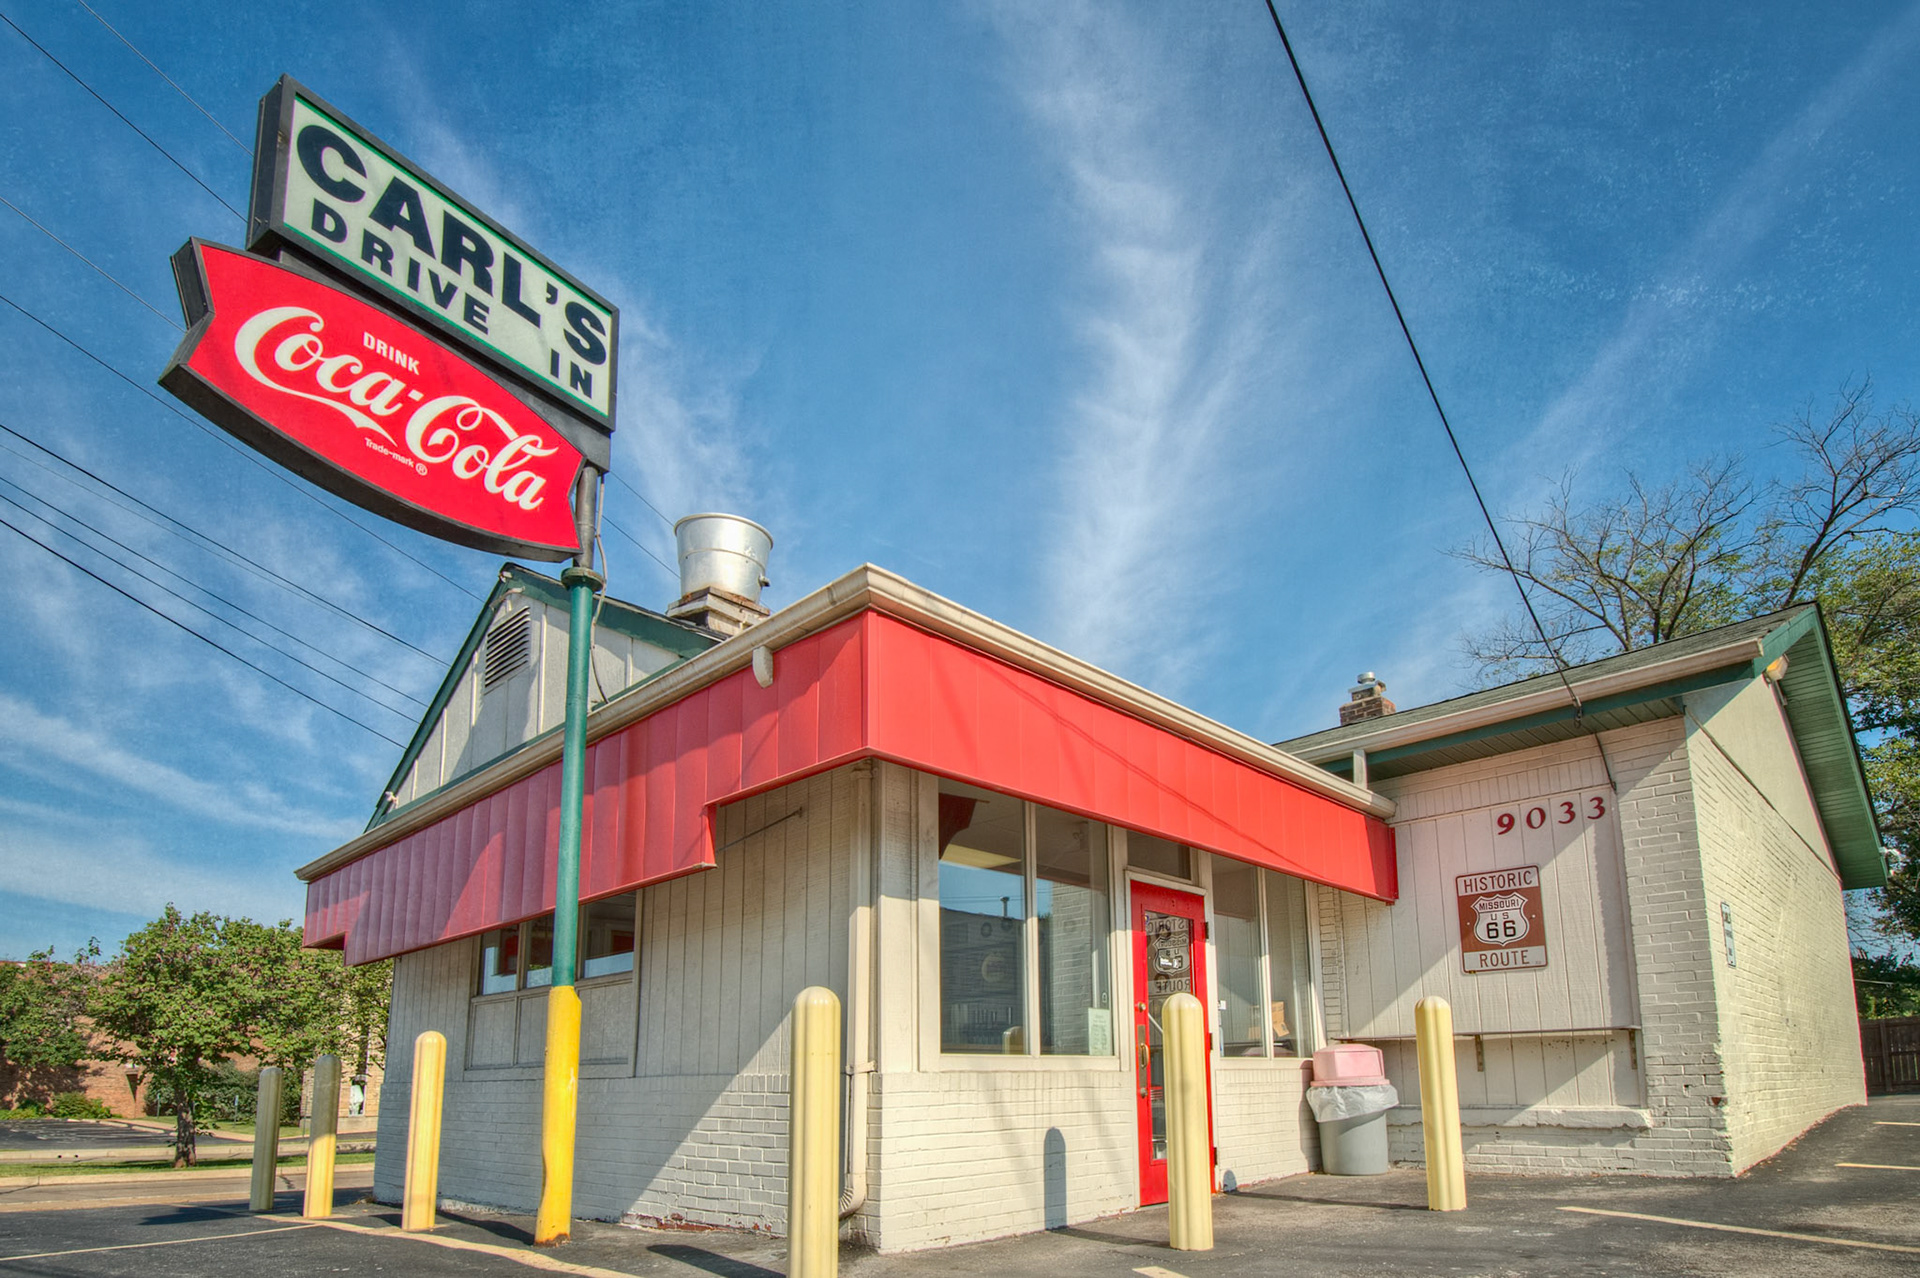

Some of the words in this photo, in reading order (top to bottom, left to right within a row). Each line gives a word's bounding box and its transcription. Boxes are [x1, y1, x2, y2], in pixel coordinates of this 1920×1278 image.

[297, 124, 607, 365] CARL'S
[311, 198, 489, 335] DRIVE
[549, 349, 593, 399] IN
[363, 331, 420, 376] DRINK
[234, 306, 559, 511] Coca-Cola
[364, 437, 415, 468] Trade-mark
[1497, 797, 1606, 835] 9033
[1463, 870, 1533, 894] HISTORIC
[1479, 899, 1520, 911] MISSOURI
[1486, 920, 1517, 939] 66
[1479, 949, 1530, 968] ROUTE
